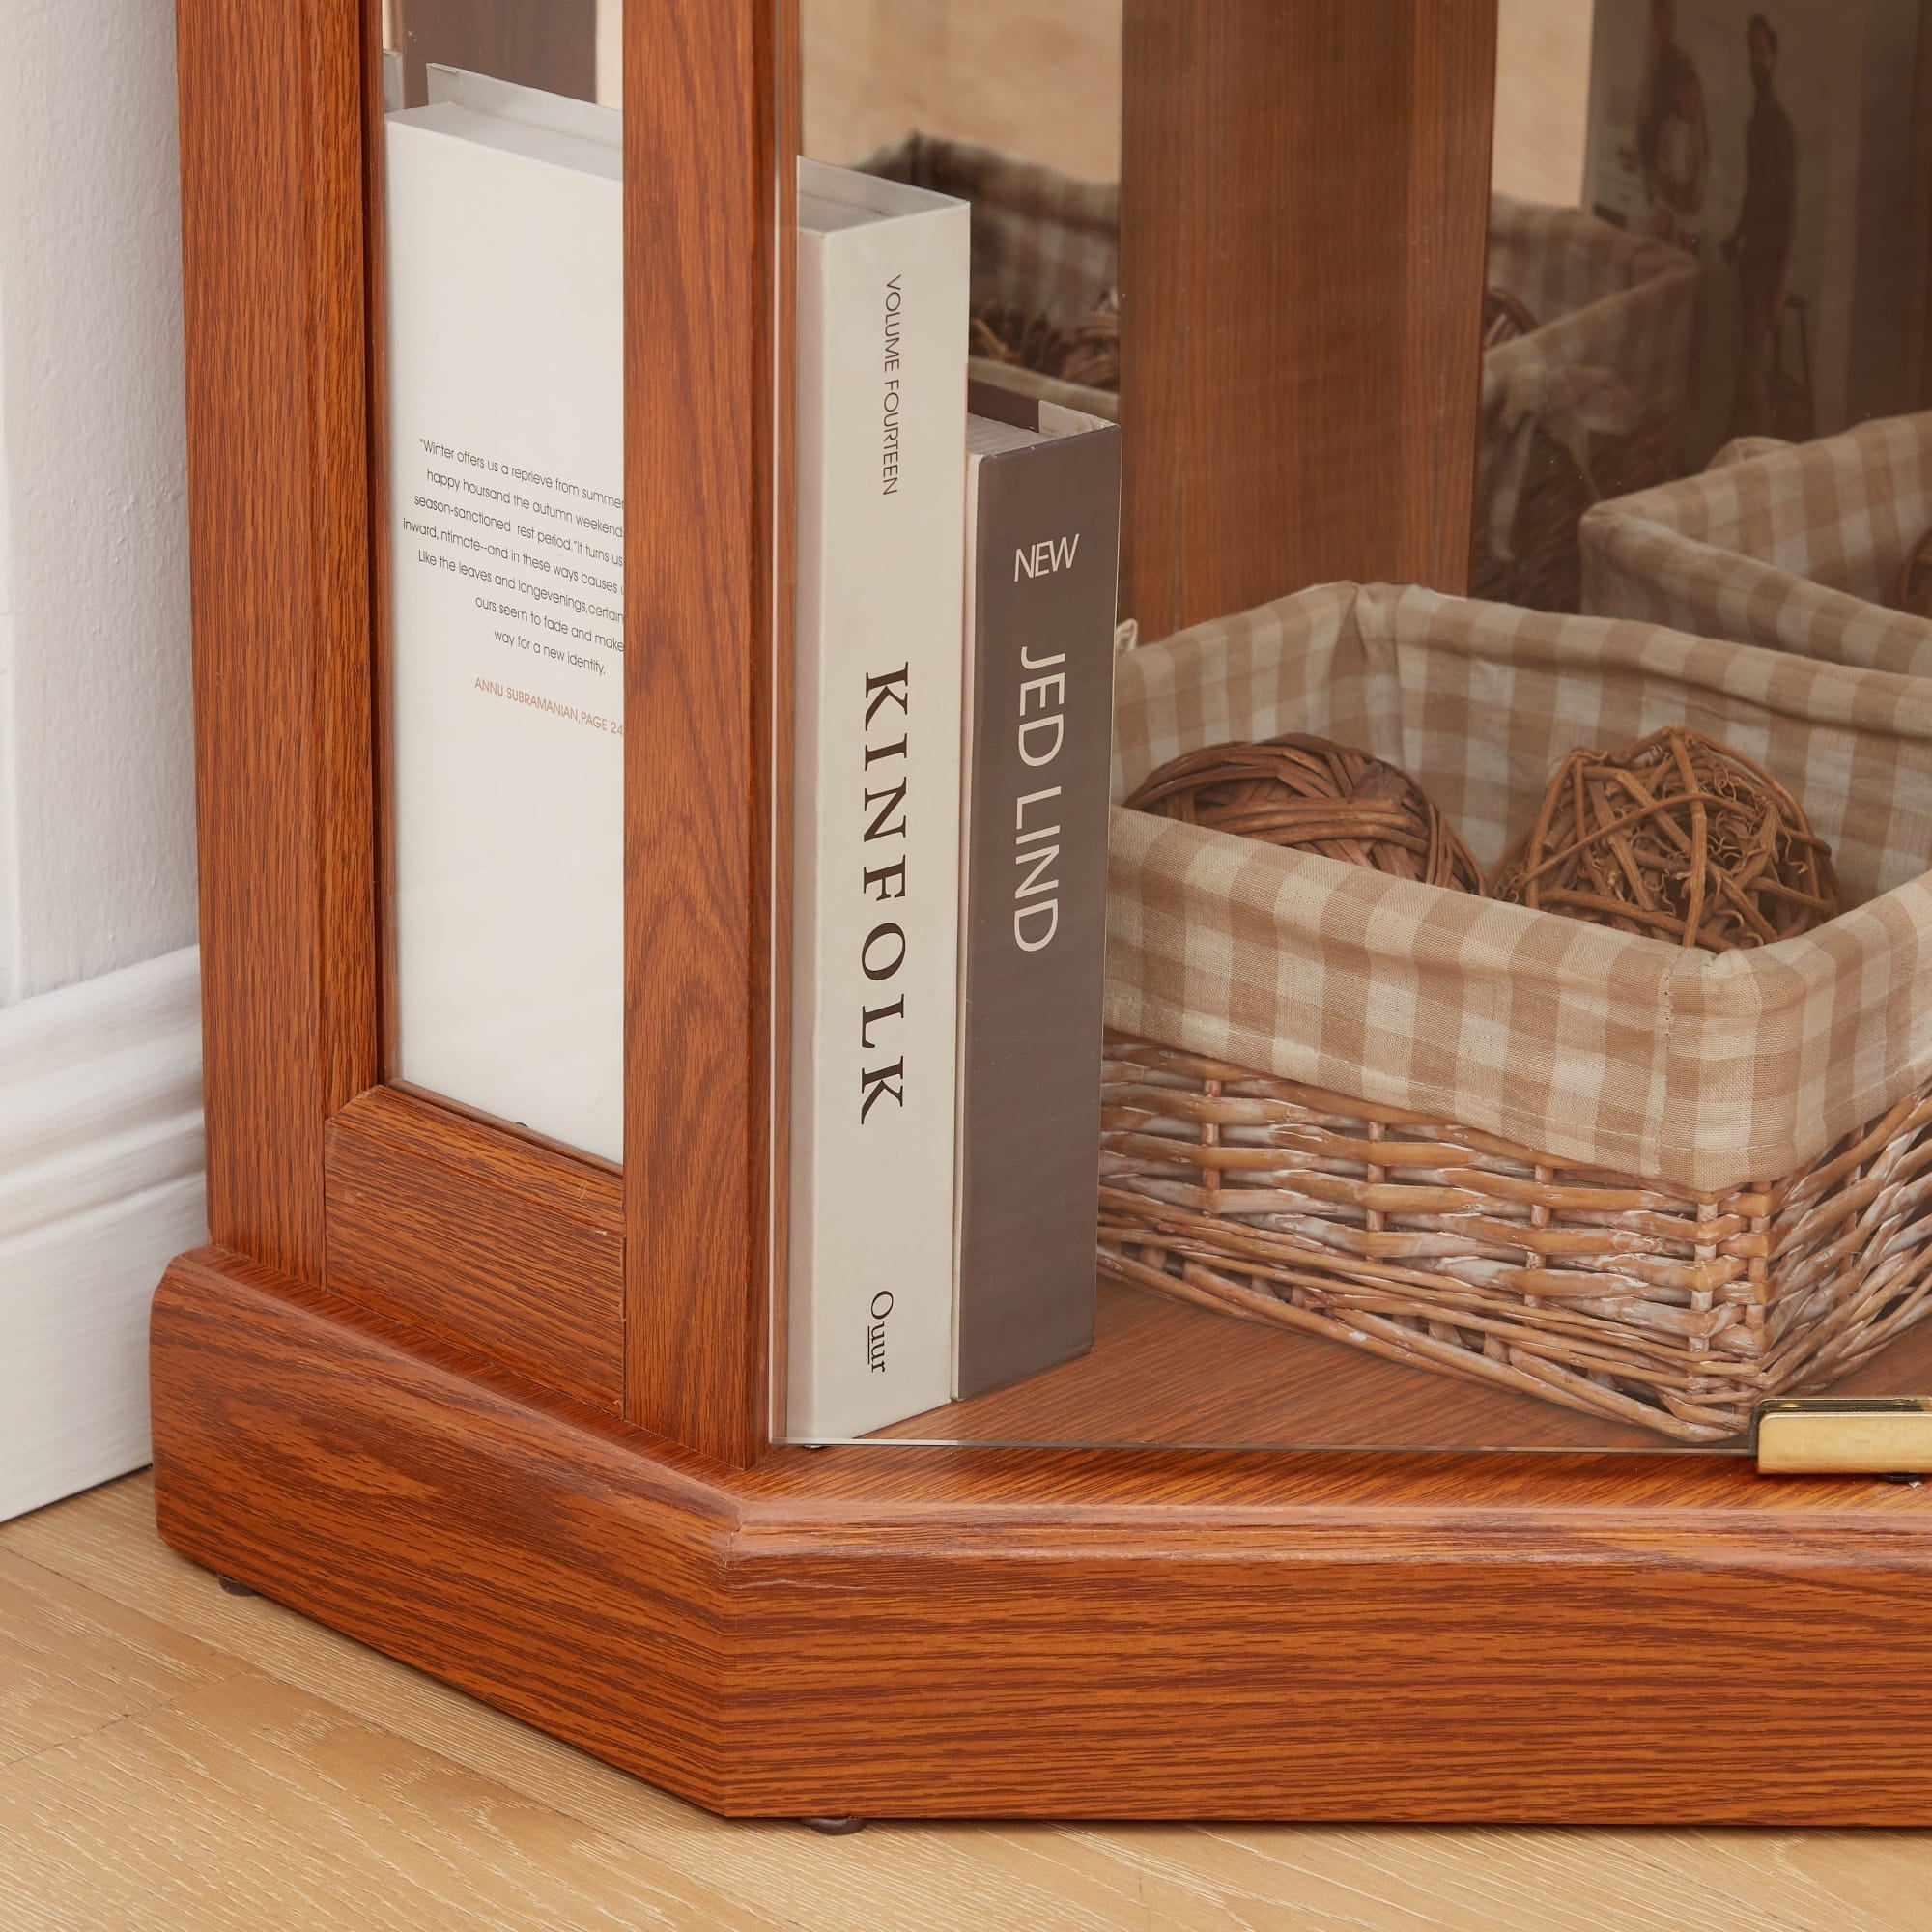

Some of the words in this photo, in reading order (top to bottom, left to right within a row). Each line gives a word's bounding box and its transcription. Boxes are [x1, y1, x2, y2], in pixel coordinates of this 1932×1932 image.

[883, 274, 902, 373] VOLUME
[881, 378, 901, 496] FOURTEEN
[426, 469, 461, 492] happy
[463, 478, 511, 504] hoursand
[513, 494, 530, 510] the
[532, 502, 573, 523] autumn
[456, 451, 485, 469] offers
[487, 459, 498, 472] us
[500, 465, 509, 475] a
[511, 467, 553, 488] reprieve
[555, 478, 580, 496] from
[413, 495, 511, 532] season-sanctioned
[517, 525, 535, 540] rest
[584, 544, 610, 563] turns
[611, 554, 623, 567] us
[1014, 533, 1080, 582] NEW
[418, 549, 437, 566] Like
[439, 556, 456, 572] the
[459, 561, 492, 583] leaves
[494, 573, 516, 590] and
[511, 549, 520, 562] in
[522, 553, 551, 573] these
[553, 563, 579, 582] ways
[581, 572, 618, 594] causes
[475, 597, 497, 612] ours
[498, 604, 528, 621] seem
[530, 611, 541, 626] to
[543, 616, 569, 635] fade
[571, 627, 592, 642] and
[594, 634, 624, 652] make
[494, 630, 516, 647] way
[517, 635, 531, 650] for
[532, 642, 541, 654] a
[543, 645, 565, 661] new
[567, 650, 607, 676] identity.
[474, 676, 503, 696] ANNU
[1015, 645, 1065, 768] JED
[860, 661, 910, 1126] KINFOLK
[1012, 785, 1061, 953] LIND
[867, 1291, 894, 1373] Ouur
